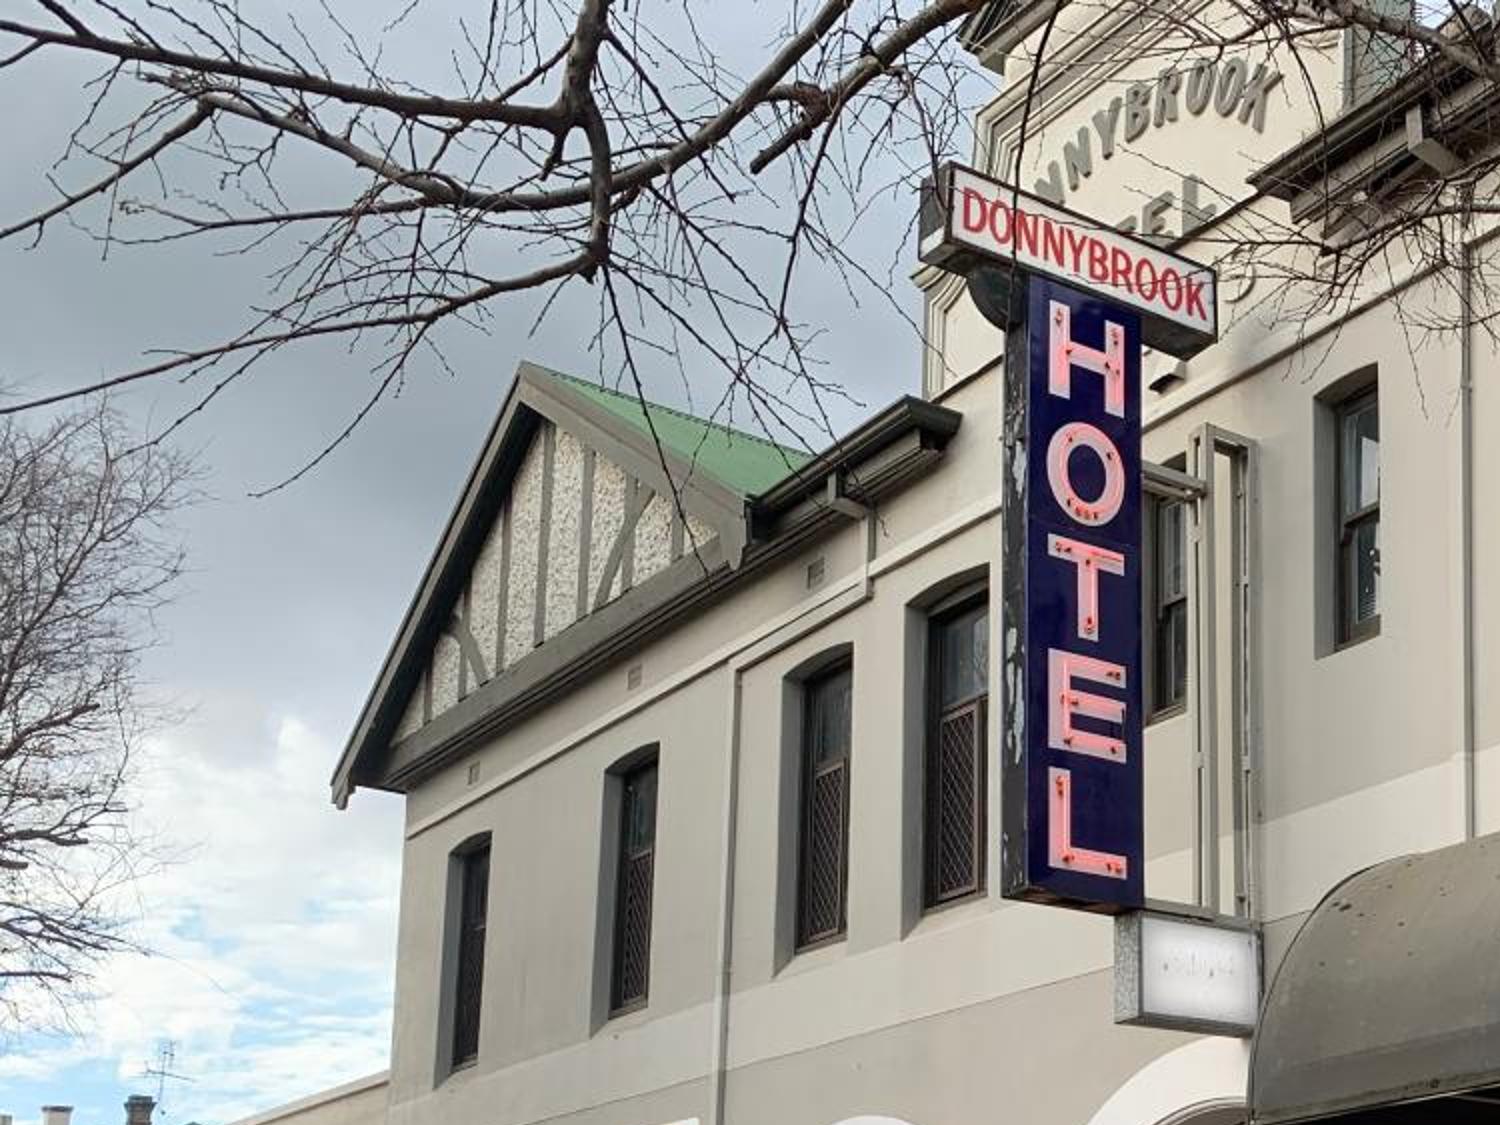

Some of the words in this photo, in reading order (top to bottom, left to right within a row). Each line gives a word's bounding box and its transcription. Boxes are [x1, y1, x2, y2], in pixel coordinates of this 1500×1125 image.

[1034, 56, 1286, 206] NNYBROOK
[961, 186, 1208, 321] DONNYBROOK
[1047, 299, 1127, 881] HOTEL
